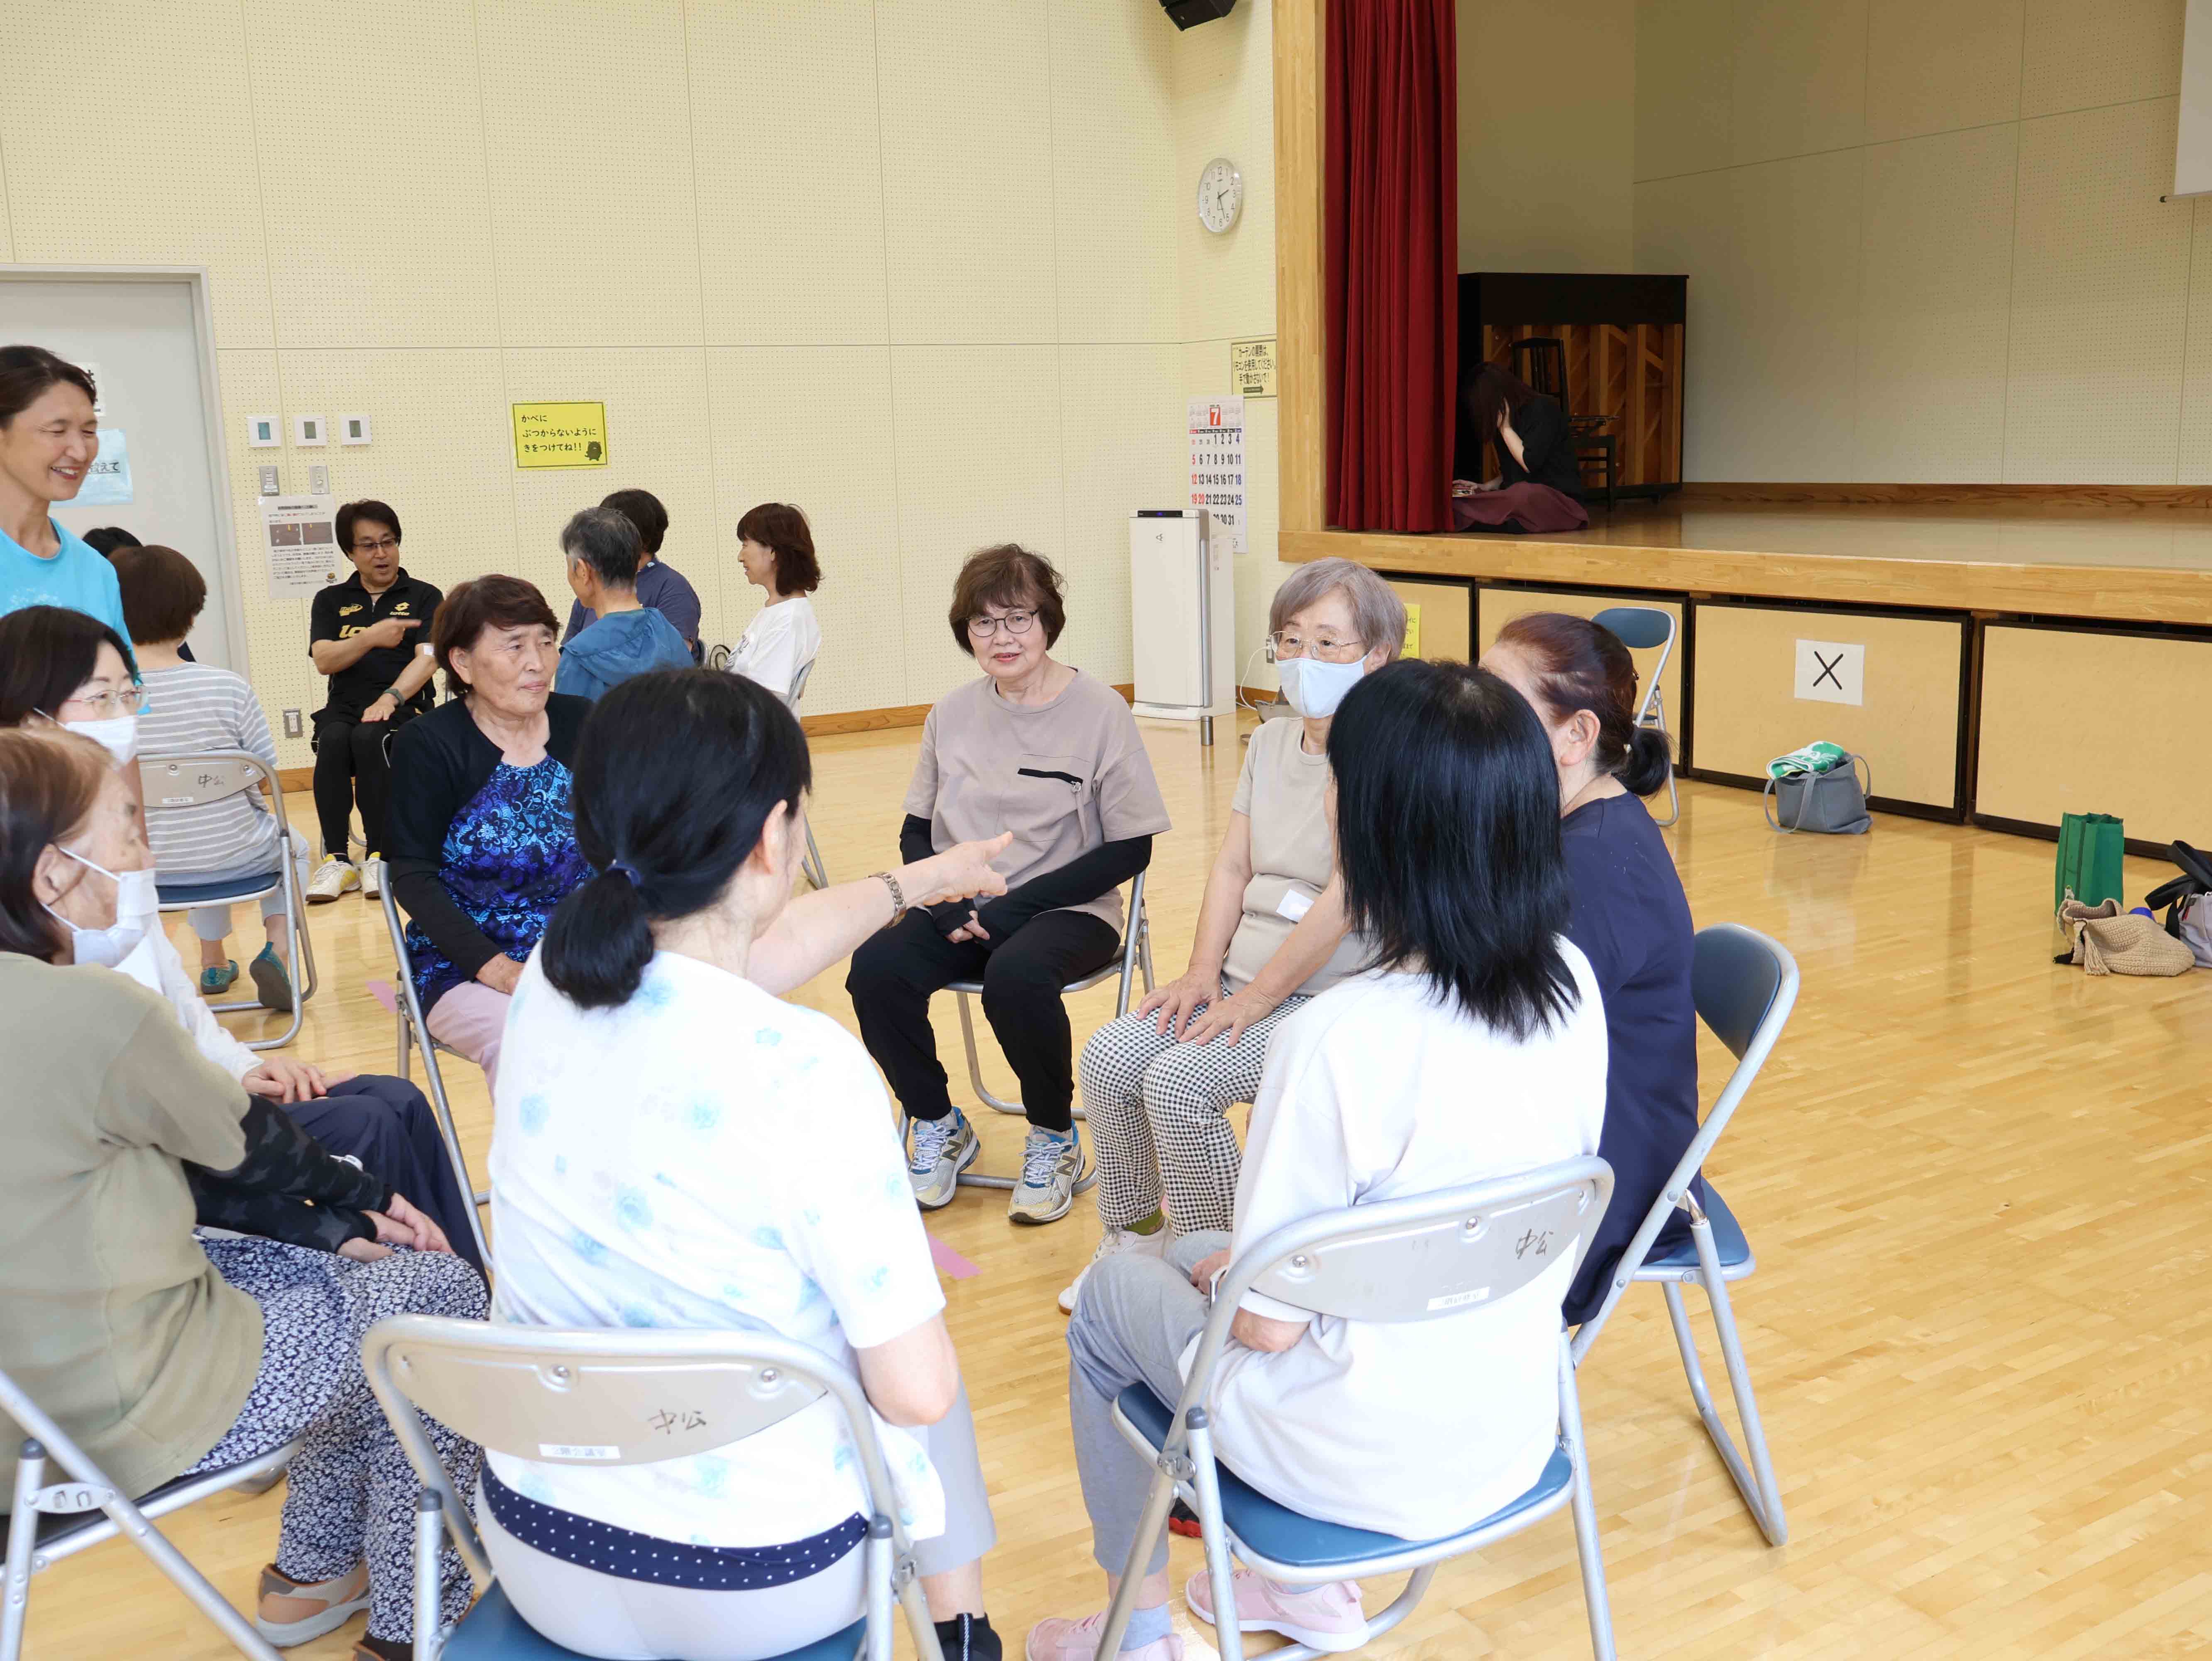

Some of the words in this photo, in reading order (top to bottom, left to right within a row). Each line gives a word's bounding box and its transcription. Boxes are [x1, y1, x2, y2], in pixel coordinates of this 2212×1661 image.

[1230, 176, 1234, 185] 2
[1232, 189, 1236, 198] 3
[1219, 218, 1223, 227] 6
[1211, 407, 1220, 425] 7
[523, 428, 597, 437] ぶつからないように
[1214, 434, 1217, 444] 1
[1221, 434, 1224, 444] 2
[1228, 434, 1232, 444] 3
[1236, 434, 1240, 444] 4
[524, 442, 582, 453] きをつけてね!!
[1192, 454, 1196, 465] 5
[1199, 454, 1203, 465] 6
[1206, 454, 1210, 465] 7
[1214, 454, 1217, 465] 8
[1221, 454, 1224, 465] 9
[1227, 454, 1233, 465] 10
[1235, 454, 1241, 465] 11
[1192, 474, 1197, 485] 12
[1199, 474, 1204, 485] 13
[1206, 474, 1212, 485] 14
[1213, 474, 1219, 485] 15
[1221, 474, 1226, 485] 16
[1228, 474, 1233, 485] 17
[1236, 474, 1241, 485] 18
[1192, 494, 1197, 505] 19
[1198, 494, 1204, 505] 20
[1206, 494, 1211, 505] 21
[1213, 494, 1219, 505] 22
[1220, 494, 1226, 505] 23
[1228, 494, 1234, 505] 24
[1235, 494, 1242, 505] 25
[1228, 514, 1234, 525] 31
[198, 774, 225, 788] 中公
[940, 1139, 963, 1162] N
[1055, 1155, 1079, 1176] N
[648, 1409, 707, 1434] 中公
